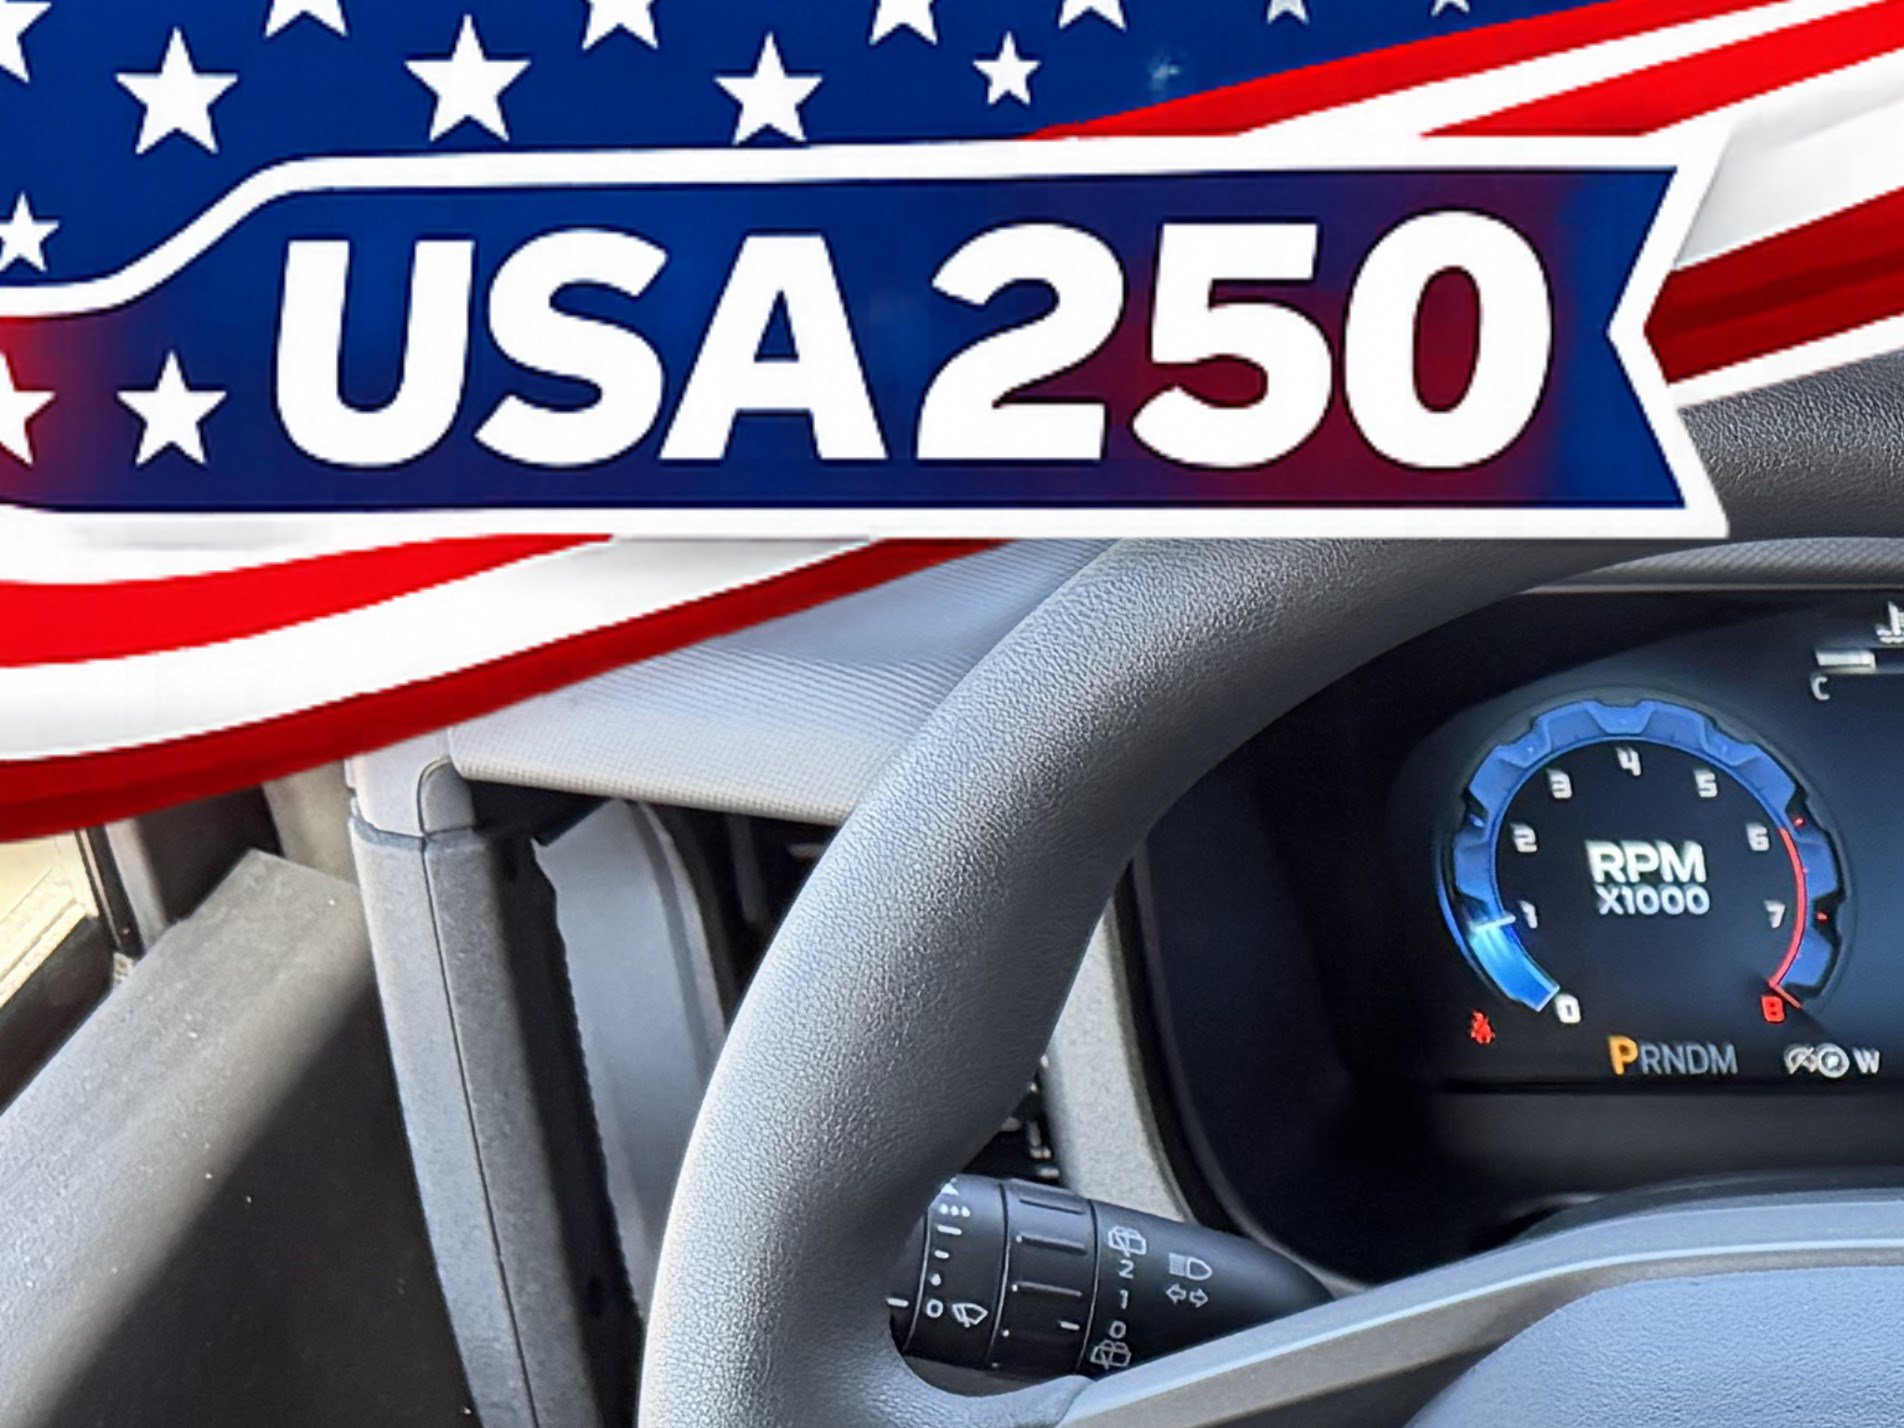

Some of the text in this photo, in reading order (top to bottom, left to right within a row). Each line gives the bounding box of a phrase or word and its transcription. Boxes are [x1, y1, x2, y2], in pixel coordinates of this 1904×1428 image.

[1811, 676, 1831, 701] C
[1615, 747, 1643, 777] 4
[1547, 769, 1573, 800] 3
[1694, 769, 1718, 799] 5
[1511, 823, 1538, 854] 2
[1746, 823, 1770, 853] 6
[1585, 839, 1708, 883] RPM
[1594, 884, 1711, 917] X1000
[1764, 901, 1787, 930] 7
[1554, 992, 1582, 1024] 0
[1761, 993, 1787, 1024] 8
[1853, 1046, 1882, 1075] W
[1118, 1259, 1135, 1280] 2
